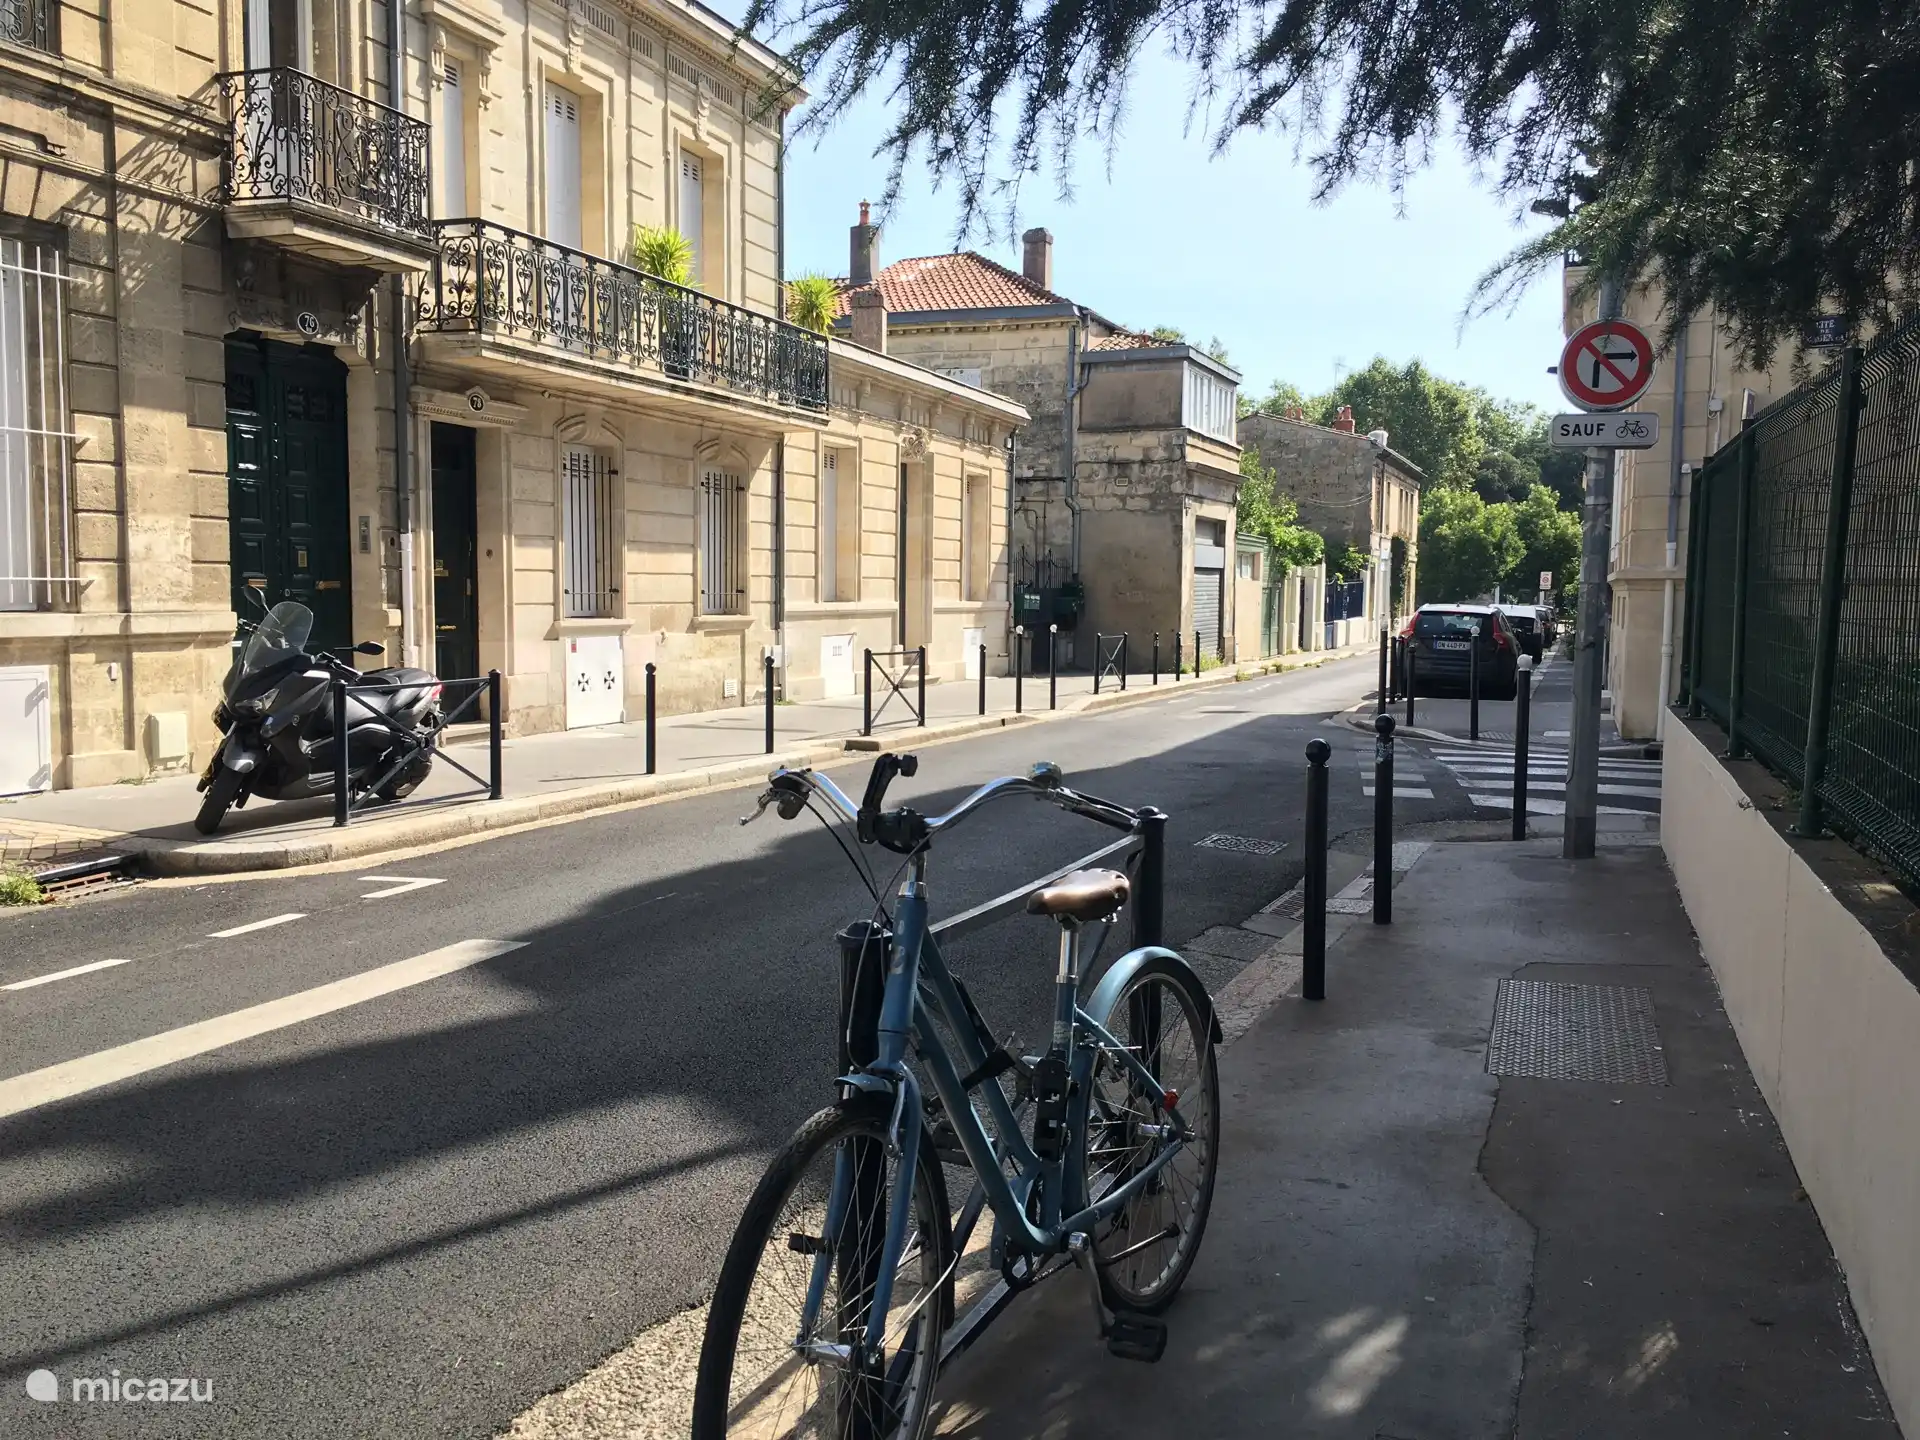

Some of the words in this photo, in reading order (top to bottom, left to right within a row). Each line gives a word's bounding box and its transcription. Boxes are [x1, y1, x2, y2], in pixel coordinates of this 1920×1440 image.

[304, 315, 315, 327] 76
[473, 397, 482, 408] 78
[1560, 423, 1606, 437] SAUF
